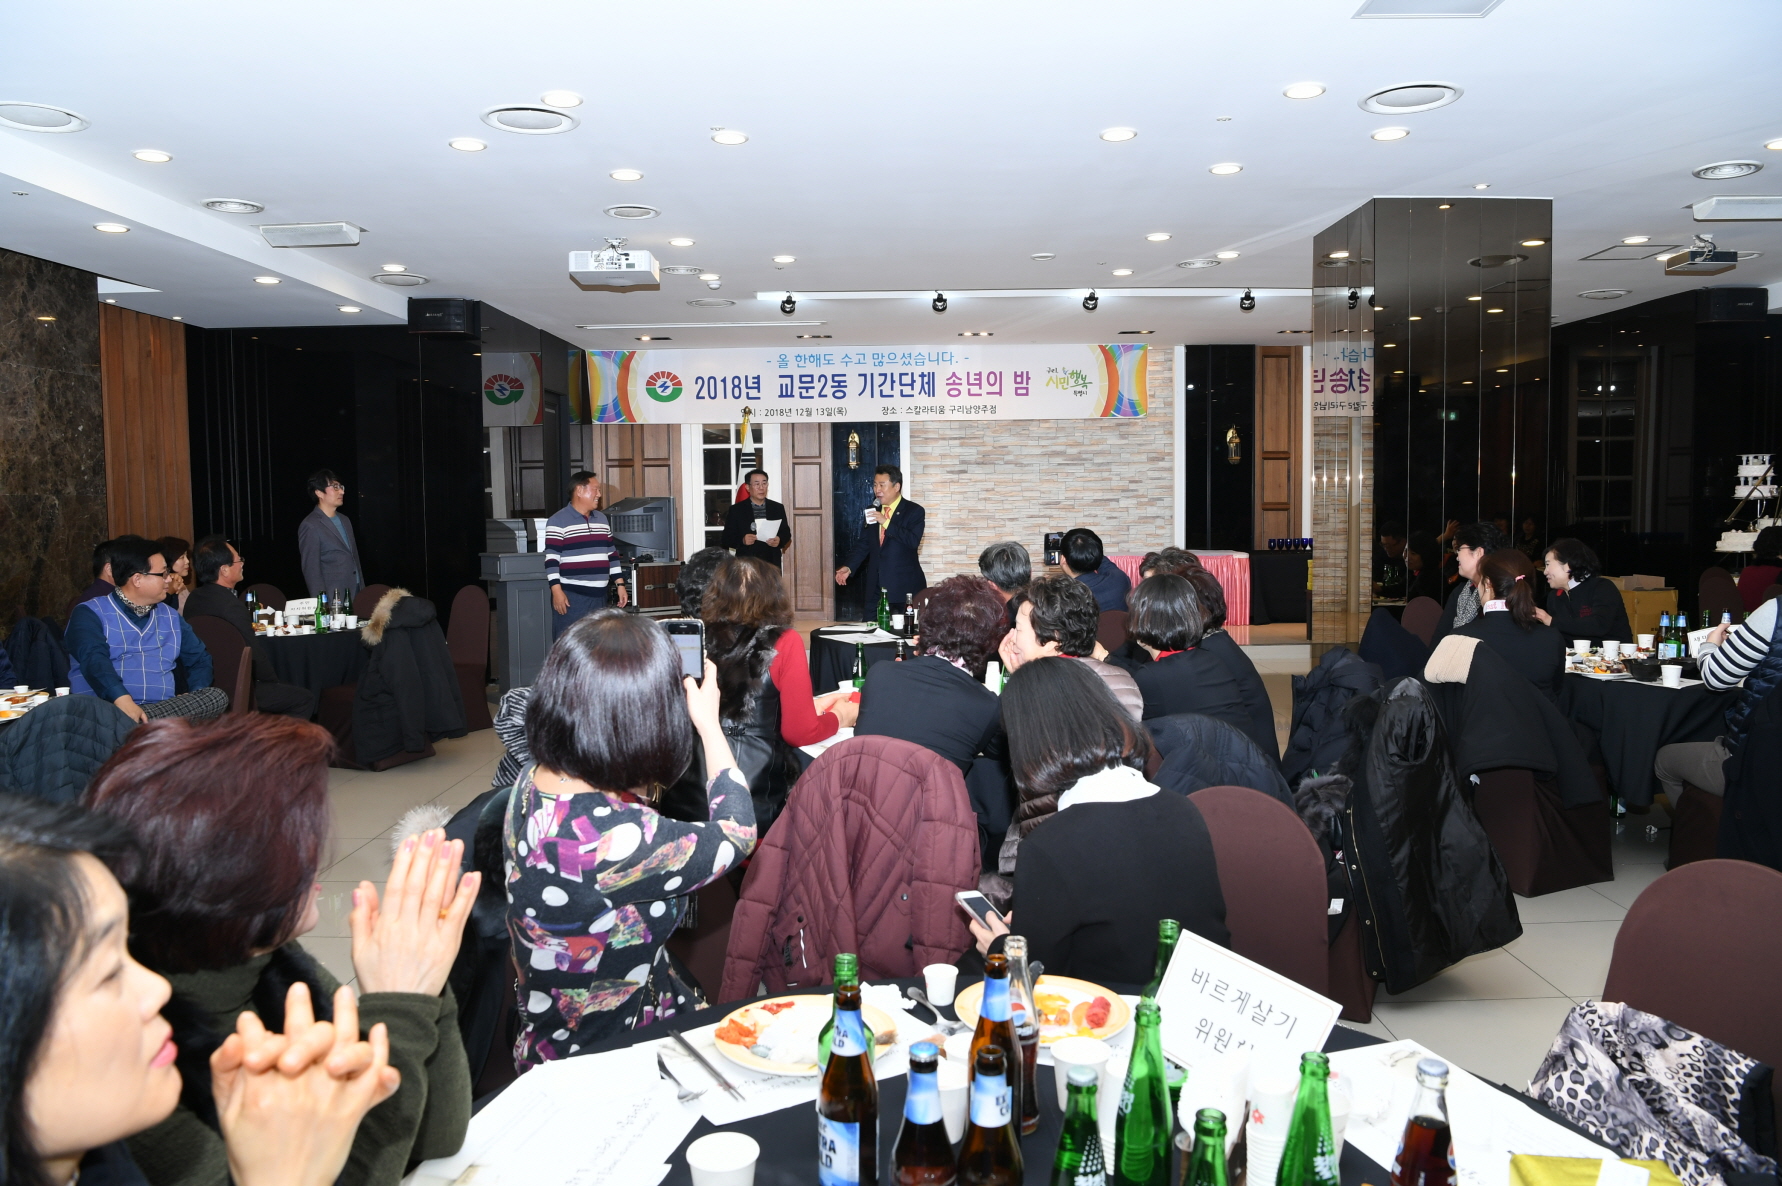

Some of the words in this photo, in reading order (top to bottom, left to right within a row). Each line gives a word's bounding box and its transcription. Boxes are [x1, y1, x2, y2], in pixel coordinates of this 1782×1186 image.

[777, 353, 790, 369] 올
[794, 353, 835, 368] 한해도
[840, 353, 867, 367] 수고
[872, 351, 959, 367] 많으셨습니다.
[695, 374, 761, 400] 2018년
[778, 373, 848, 400] 교문2동
[858, 371, 936, 399] 기간단체
[945, 371, 1003, 398] 송년의
[1013, 371, 1031, 397] 밤
[764, 408, 792, 417] 2018년
[795, 407, 813, 417] 12월
[815, 407, 848, 417] 13일(목)
[881, 405, 898, 415] 장소
[905, 405, 946, 415] 스칼라티움
[948, 404, 997, 415] 구리남양주점
[1191, 968, 1298, 1040] 바르게살기
[1194, 1018, 1254, 1054] 위원
